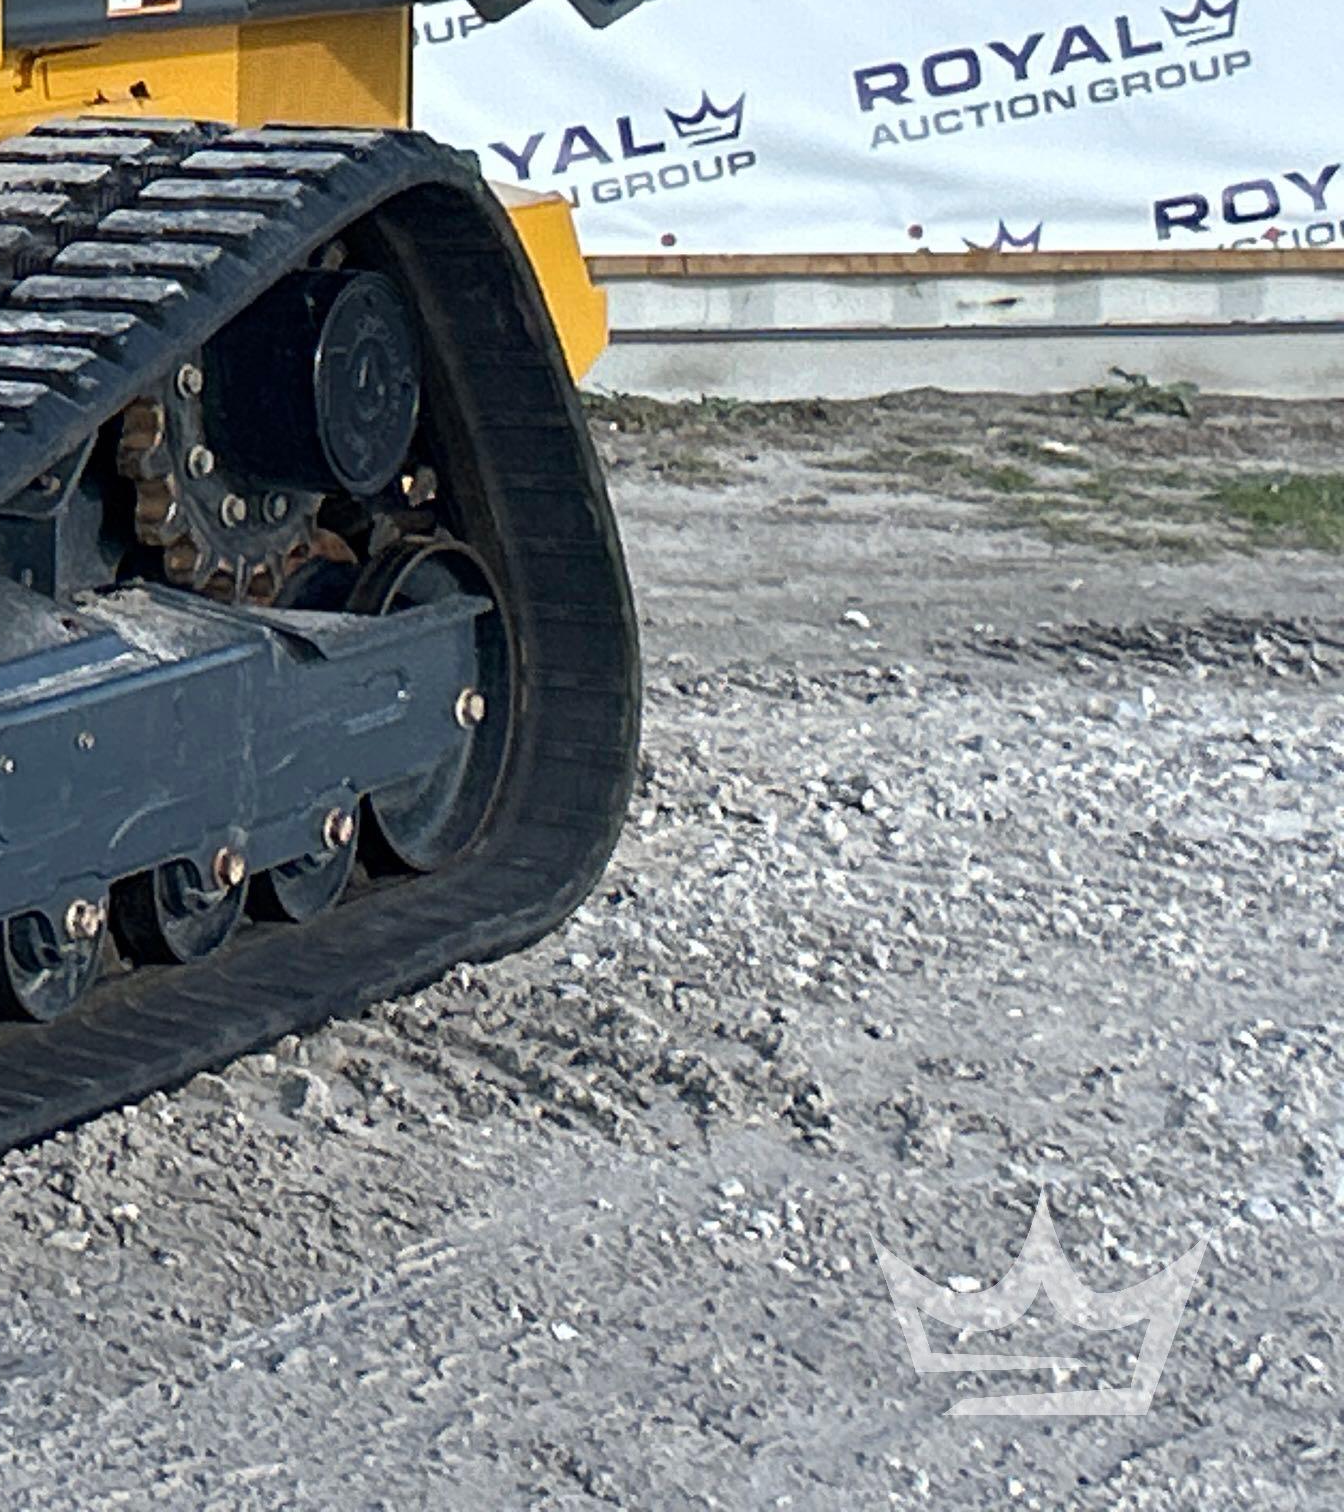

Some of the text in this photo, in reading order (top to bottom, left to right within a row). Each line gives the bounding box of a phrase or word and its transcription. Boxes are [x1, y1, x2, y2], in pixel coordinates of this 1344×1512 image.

[852, 14, 1166, 114] ROYAL
[867, 49, 1253, 150] AUCTION GROUP
[485, 114, 669, 183] YAL
[589, 150, 758, 206] GROUP
[1151, 160, 1344, 244] ROY
